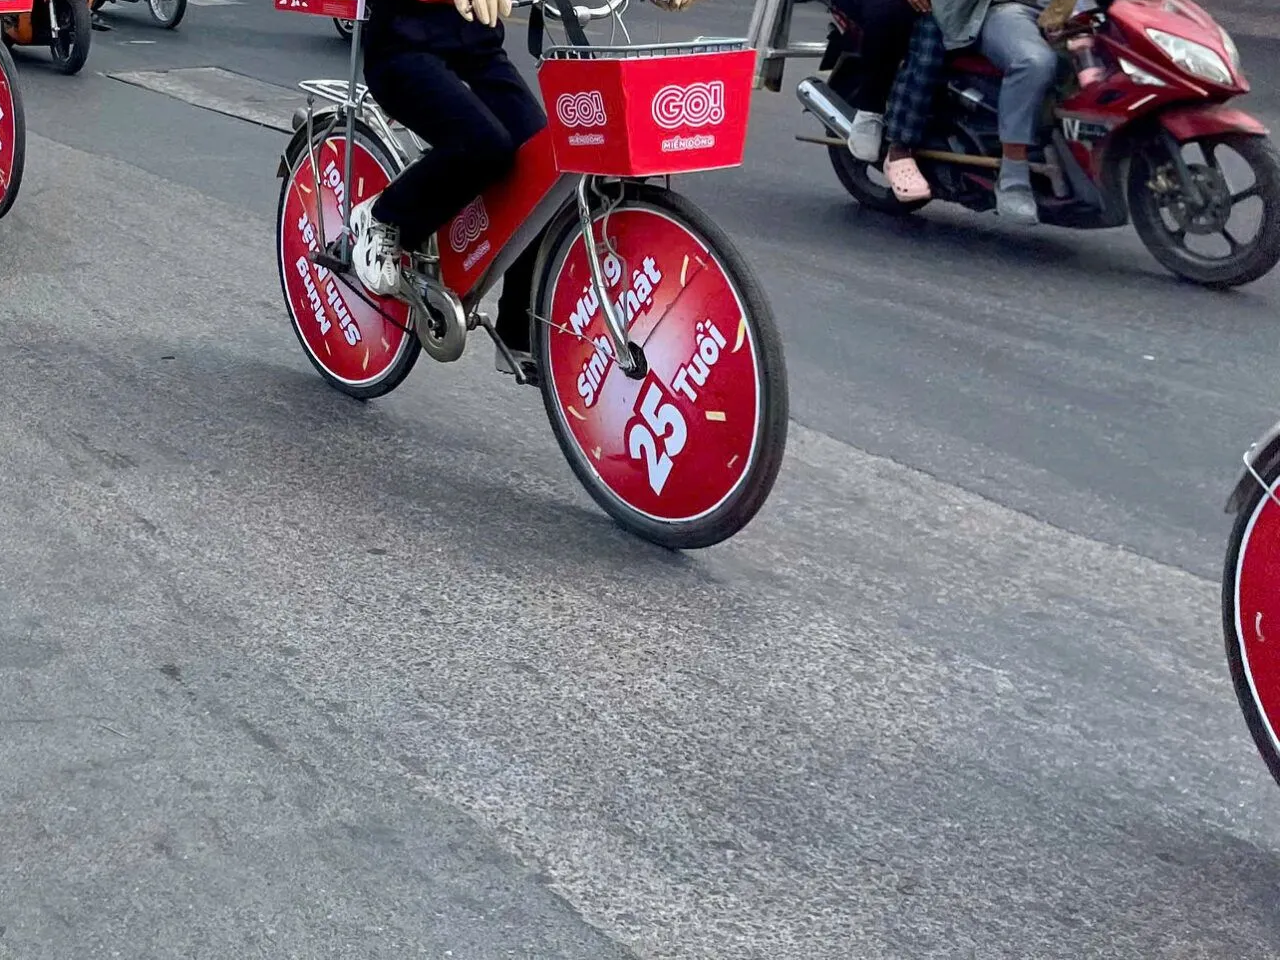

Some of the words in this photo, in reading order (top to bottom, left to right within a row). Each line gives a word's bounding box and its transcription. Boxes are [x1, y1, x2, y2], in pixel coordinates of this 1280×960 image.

[556, 90, 607, 128] GO!
[651, 80, 725, 130] GO!
[662, 137, 686, 153] MIỀN
[577, 334, 614, 407] Sinh
[629, 381, 688, 496] 25
[670, 318, 728, 403] Tuổi
